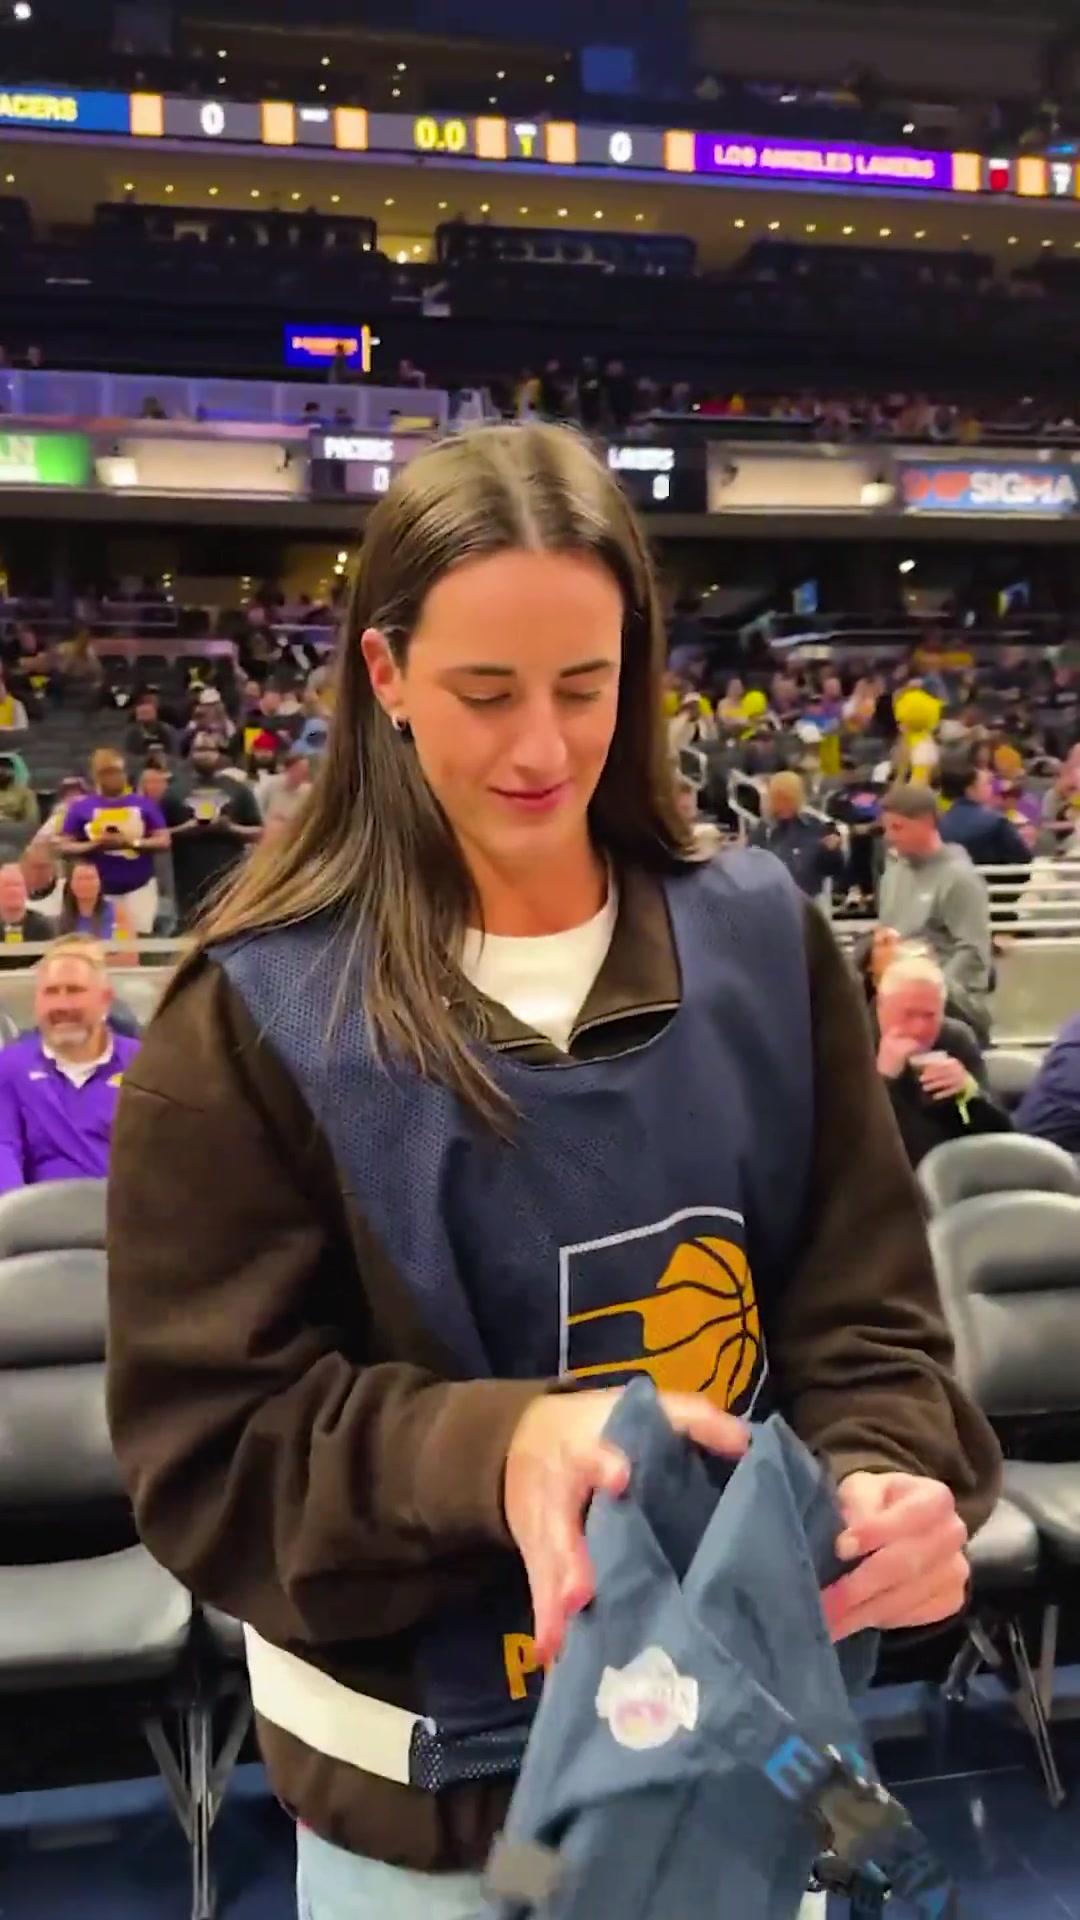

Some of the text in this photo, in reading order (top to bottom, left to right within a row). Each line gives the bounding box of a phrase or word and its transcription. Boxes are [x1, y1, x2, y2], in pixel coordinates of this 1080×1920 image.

[200, 102, 225, 136] 0
[413, 117, 467, 153] 0.0
[608, 130, 633, 164] 0
[714, 144, 756, 168] LOS
[968, 470, 1078, 506] SIGMA
